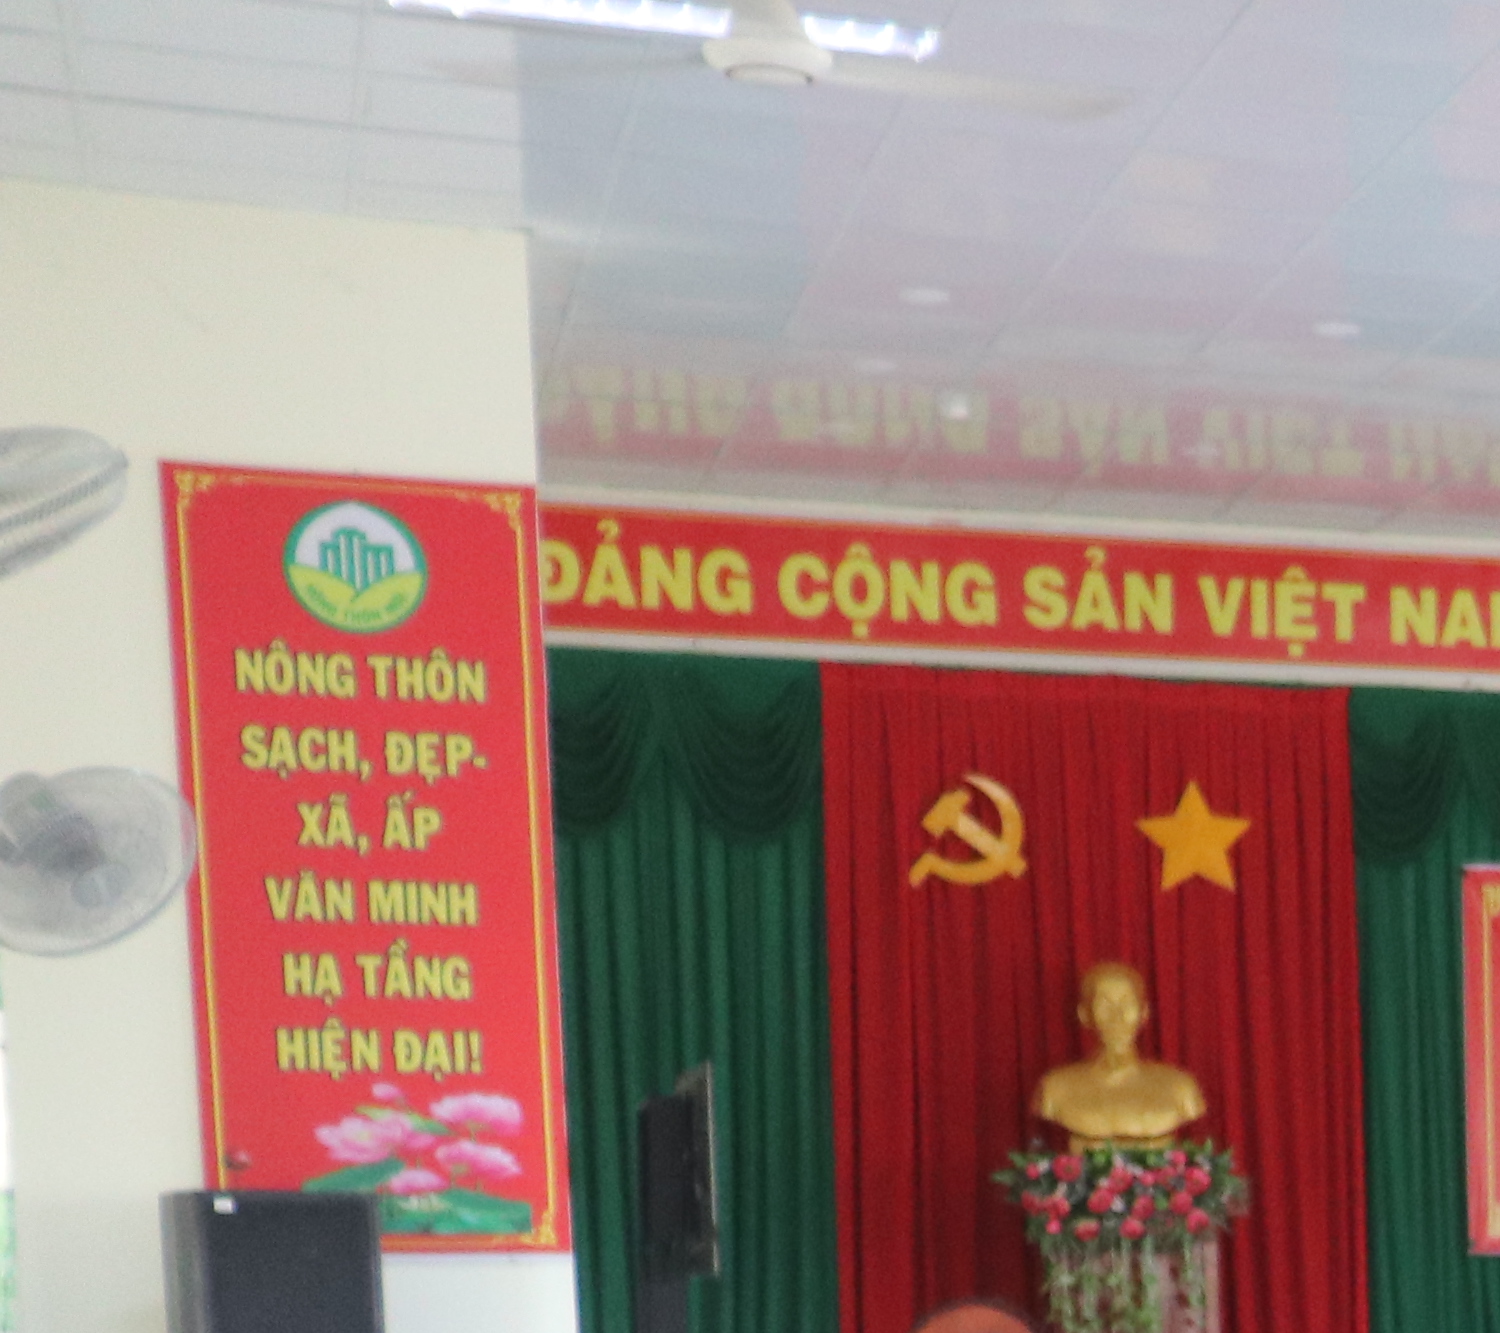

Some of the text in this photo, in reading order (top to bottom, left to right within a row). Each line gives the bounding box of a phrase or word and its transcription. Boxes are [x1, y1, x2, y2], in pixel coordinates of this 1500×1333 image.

[541, 519, 754, 615] ĐẢNG
[777, 540, 998, 640] CỘNG
[1022, 546, 1174, 635] SẢN
[1198, 565, 1367, 658] VIỆT
[234, 638, 486, 703] NÔNG THÔN
[241, 724, 488, 786] SẠCH, ĐẸP-
[297, 790, 442, 856] XÃ, ẤP
[264, 869, 478, 926] VĂN MINH
[282, 937, 471, 1006] HẠ TẦNG
[276, 1016, 482, 1082] HIỆN ĐẠI!
